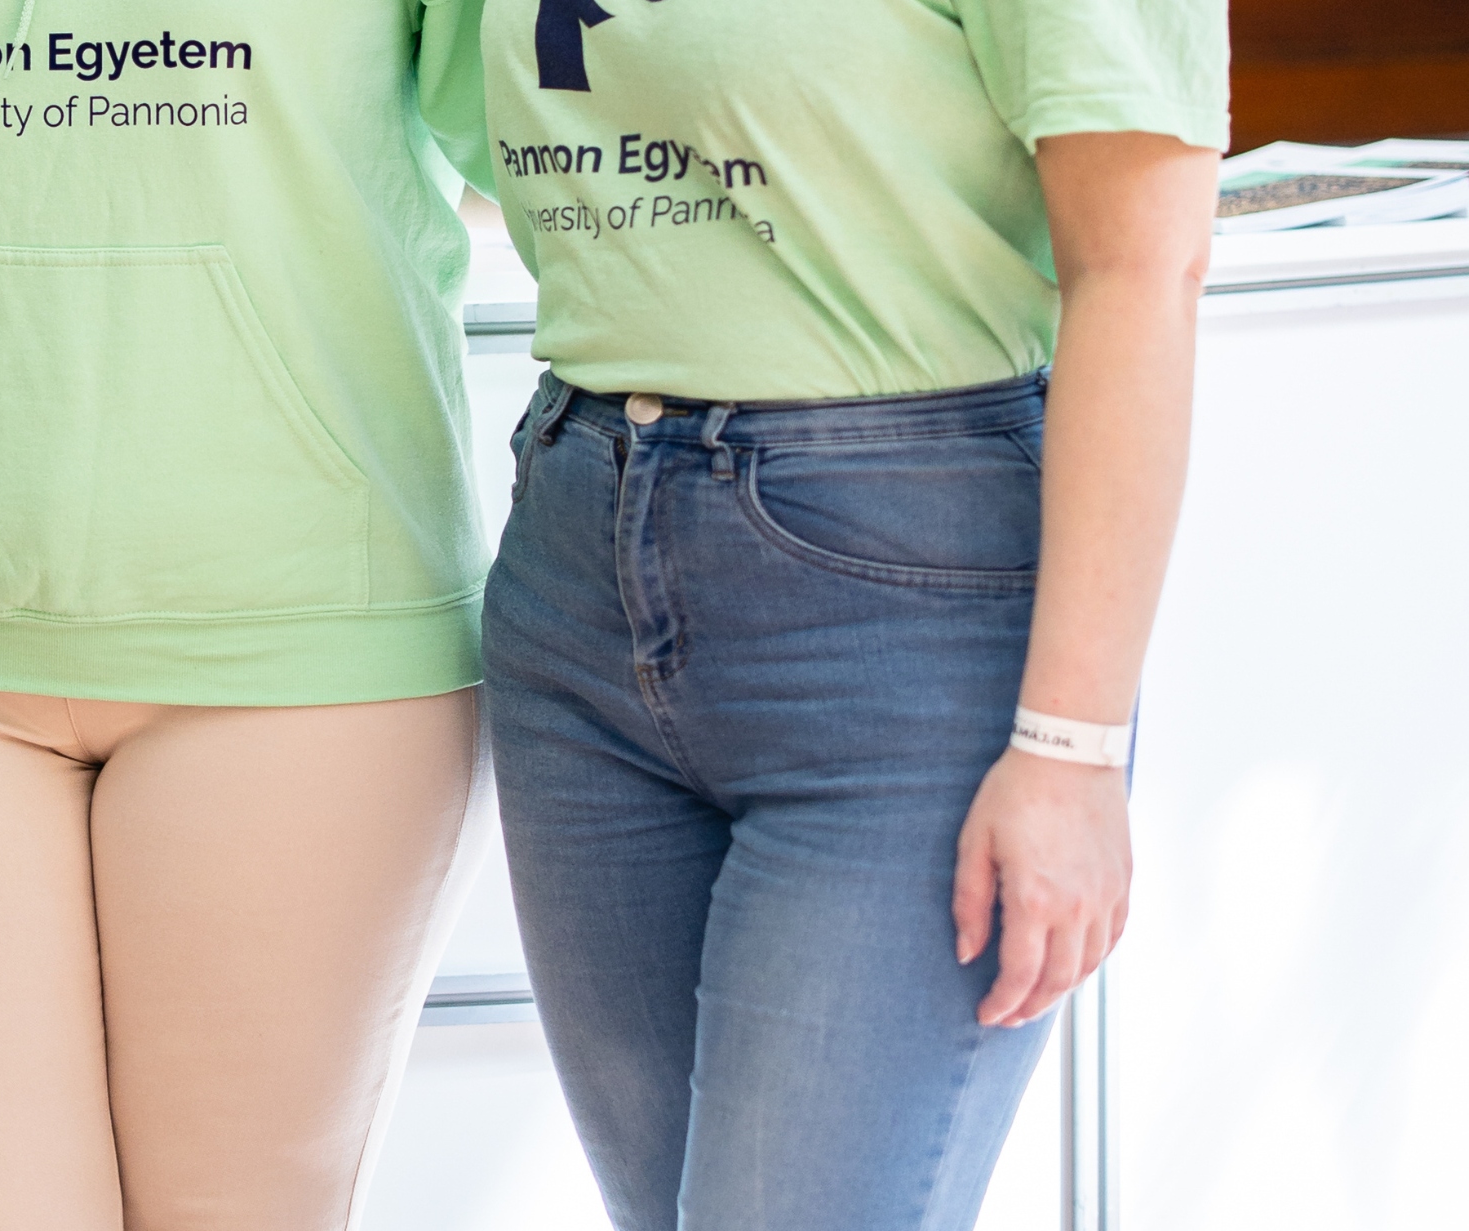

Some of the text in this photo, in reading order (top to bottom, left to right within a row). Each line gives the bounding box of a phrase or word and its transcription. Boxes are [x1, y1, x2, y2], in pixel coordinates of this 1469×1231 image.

[48, 31, 253, 82] Egyetem
[43, 95, 79, 129] of
[89, 93, 249, 127] Pannonia
[498, 140, 603, 178] Pannon
[607, 196, 644, 230] of
